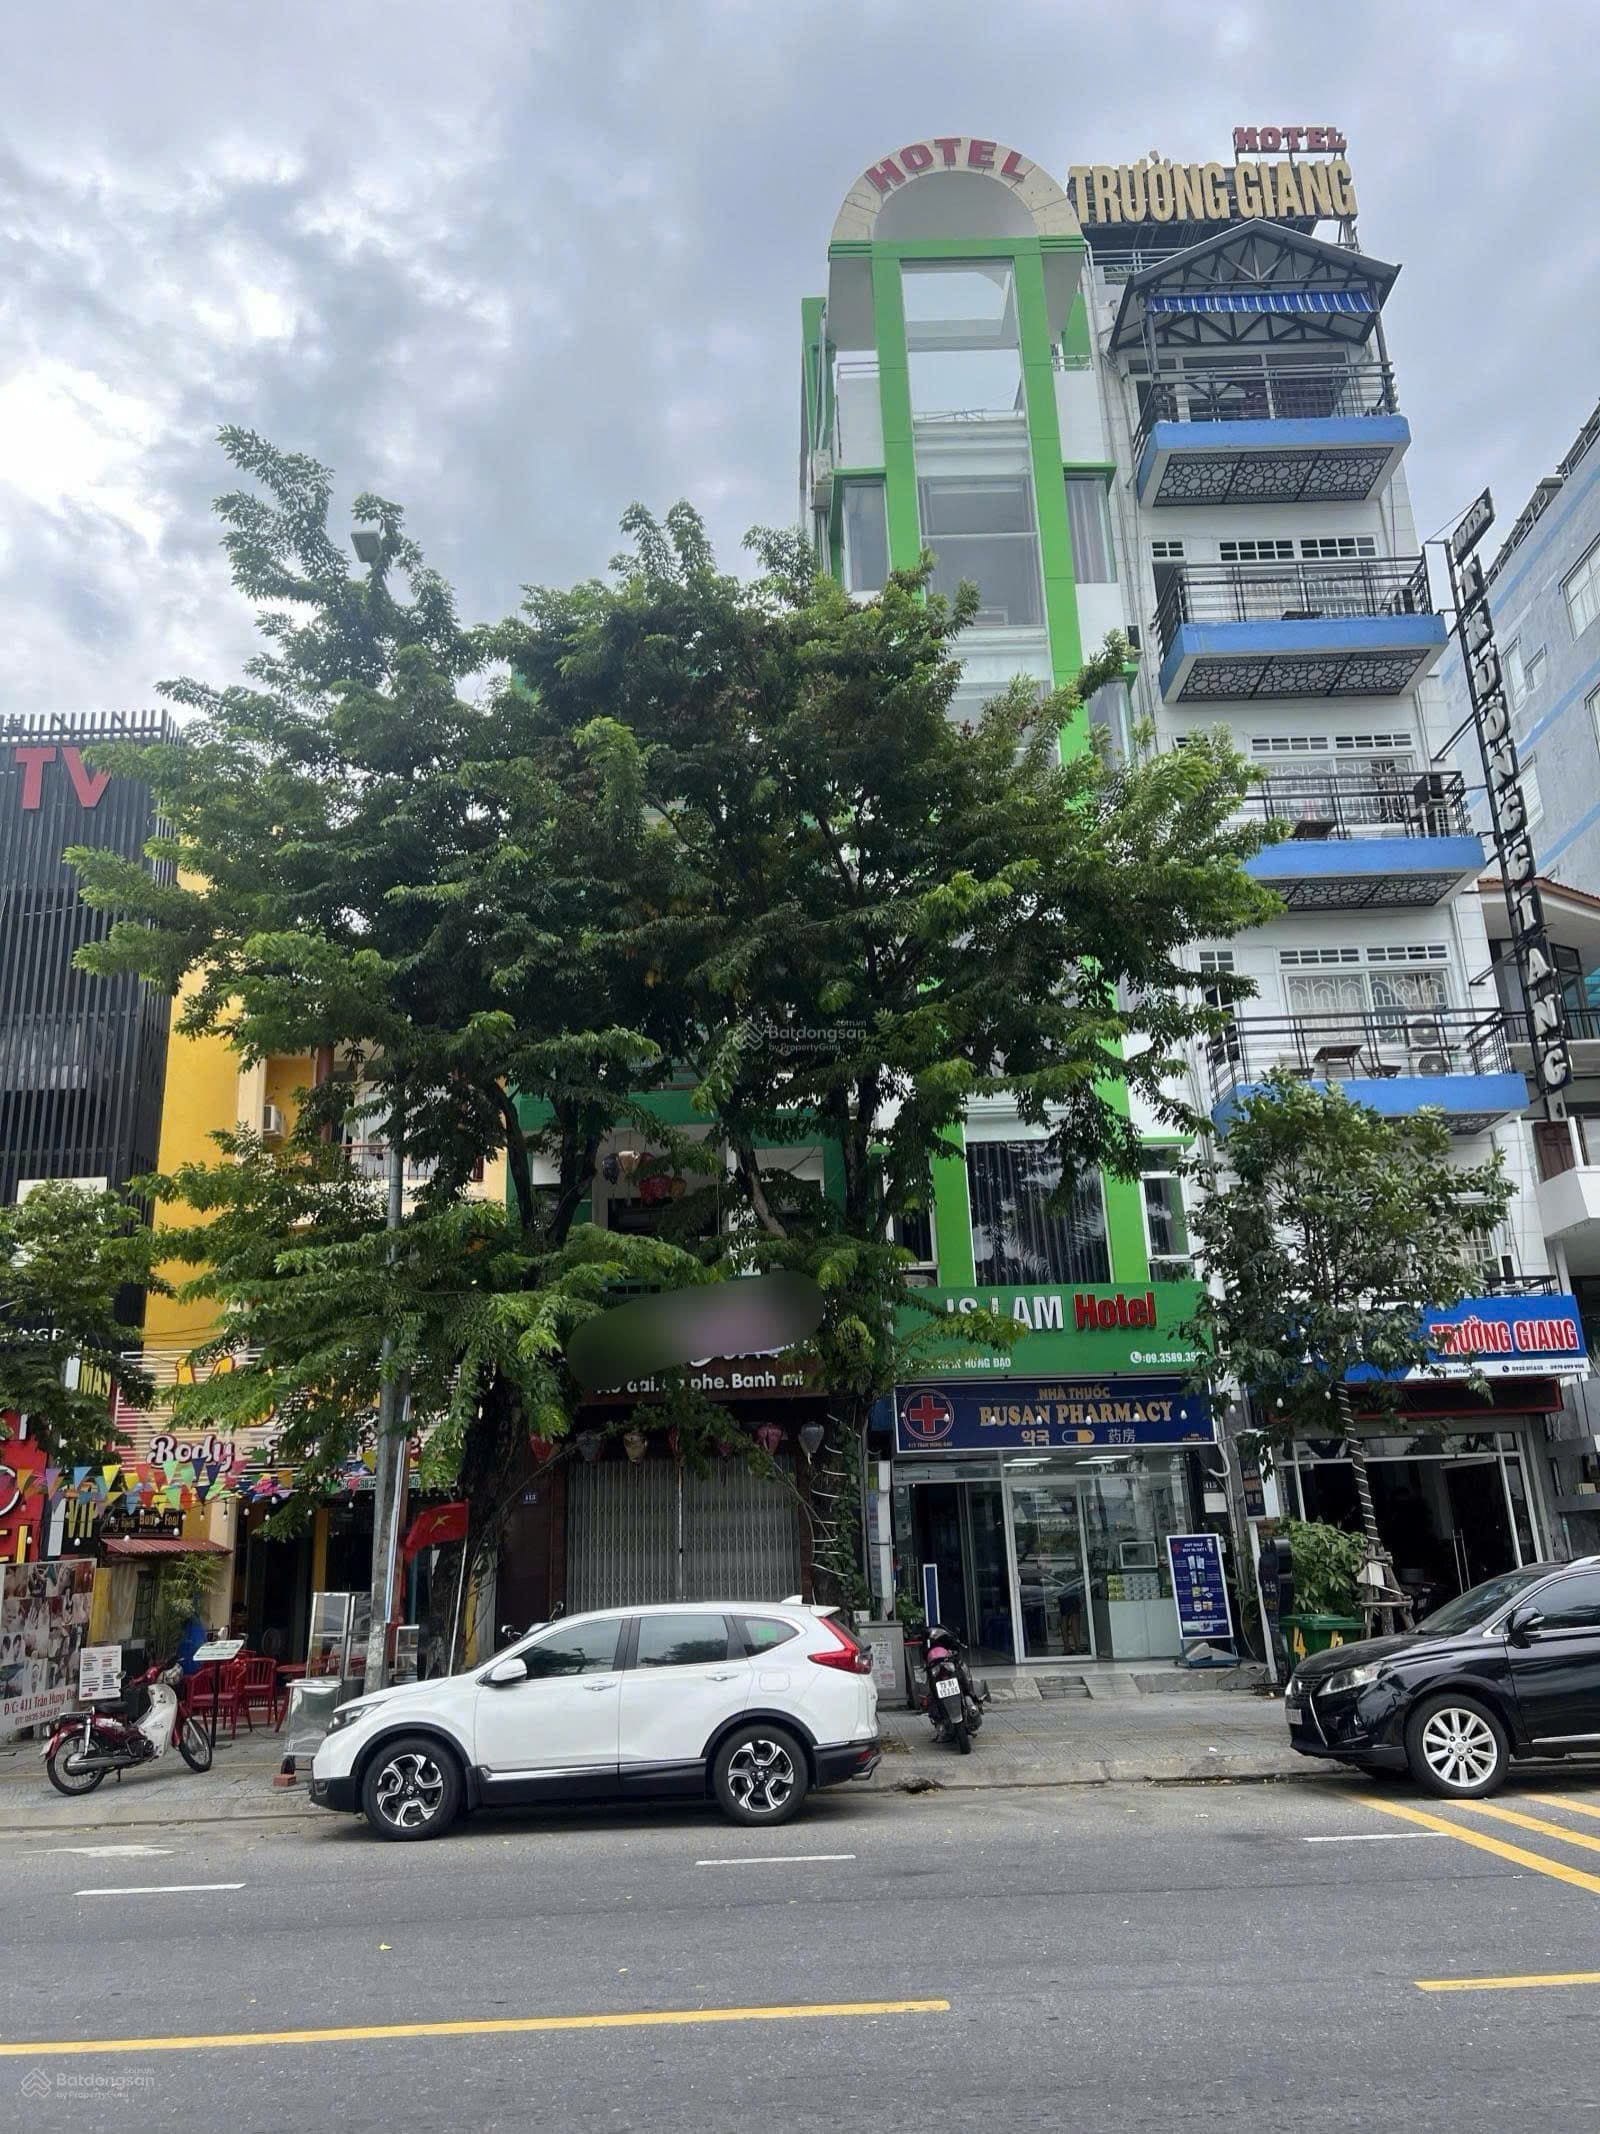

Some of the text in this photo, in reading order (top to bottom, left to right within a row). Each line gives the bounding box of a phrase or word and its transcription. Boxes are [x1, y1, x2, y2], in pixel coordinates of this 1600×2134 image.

[1233, 126, 1347, 152] HOTEL
[865, 137, 1027, 193] HOTEL
[1069, 150, 1359, 224] TRƯỜNG GIANG
[1506, 843, 1568, 1087] GIANG
[1073, 1292, 1157, 1329] Hotel
[1513, 1318, 1578, 1352] GIANG
[732, 1371, 776, 1389] Banh
[1038, 1384, 1111, 1400] NHÀ THUỐC
[978, 1400, 1173, 1427] BUSAN PHARMACY
[1020, 1429, 1050, 1447] 약국
[1107, 1429, 1137, 1444] 药房
[147, 1434, 236, 1473] Body
